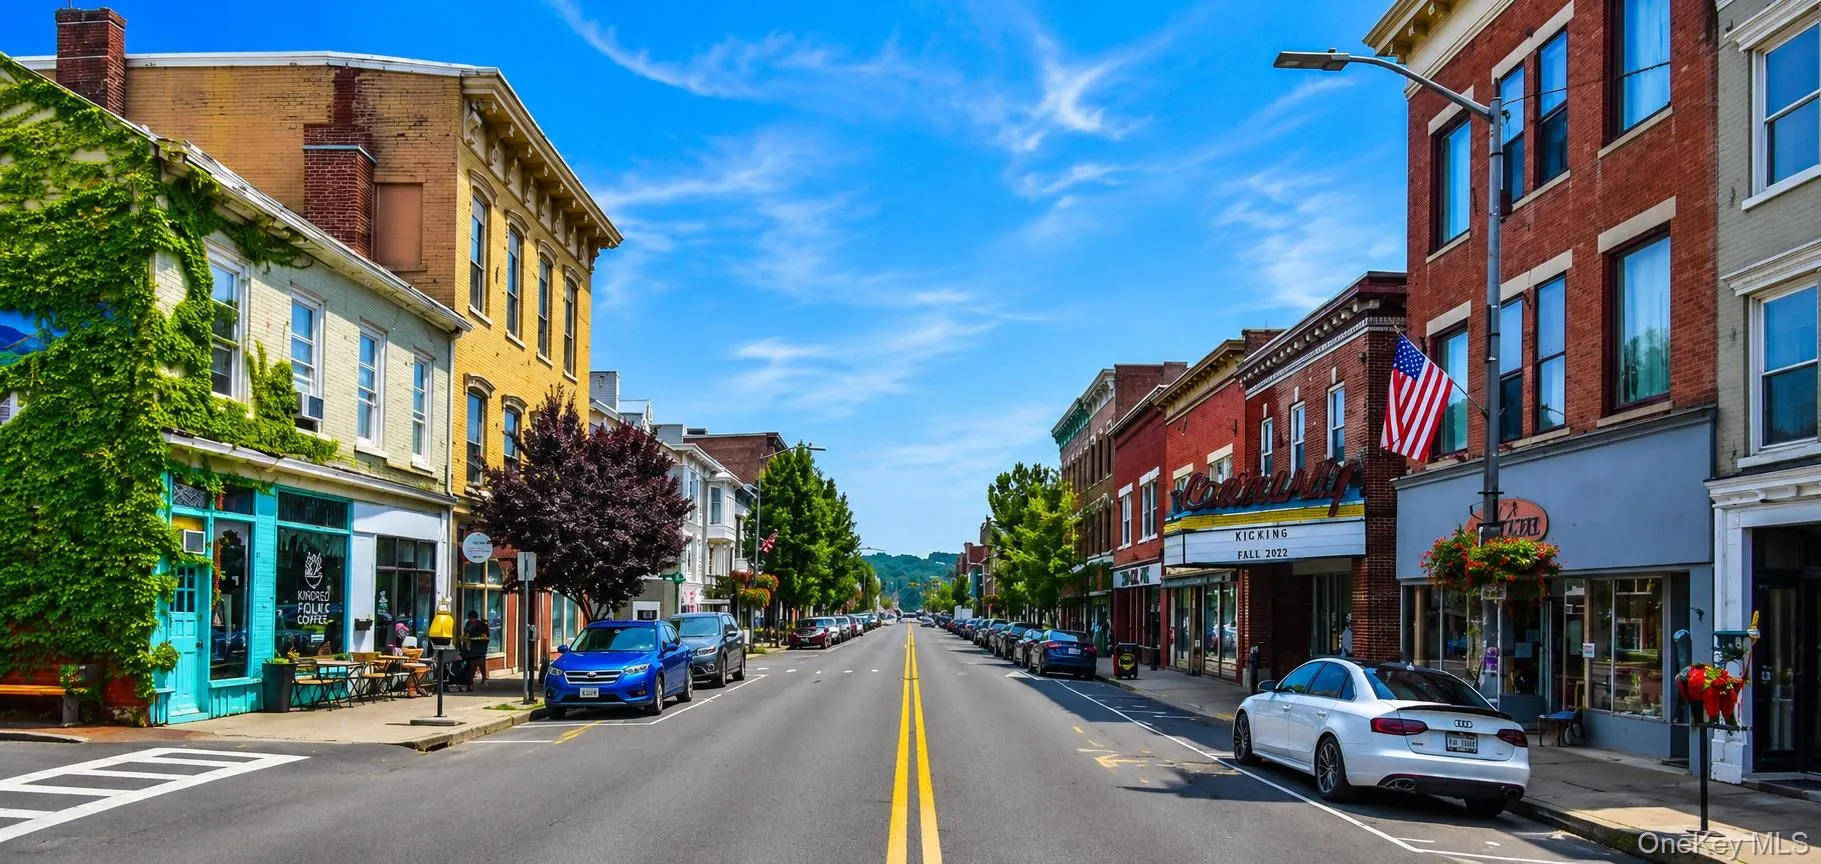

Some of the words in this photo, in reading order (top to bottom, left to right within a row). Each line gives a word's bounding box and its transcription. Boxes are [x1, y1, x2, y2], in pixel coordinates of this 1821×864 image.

[1235, 529, 1287, 541] KICKING
[1237, 550, 1260, 560] FALL
[1265, 549, 1288, 558] 2022
